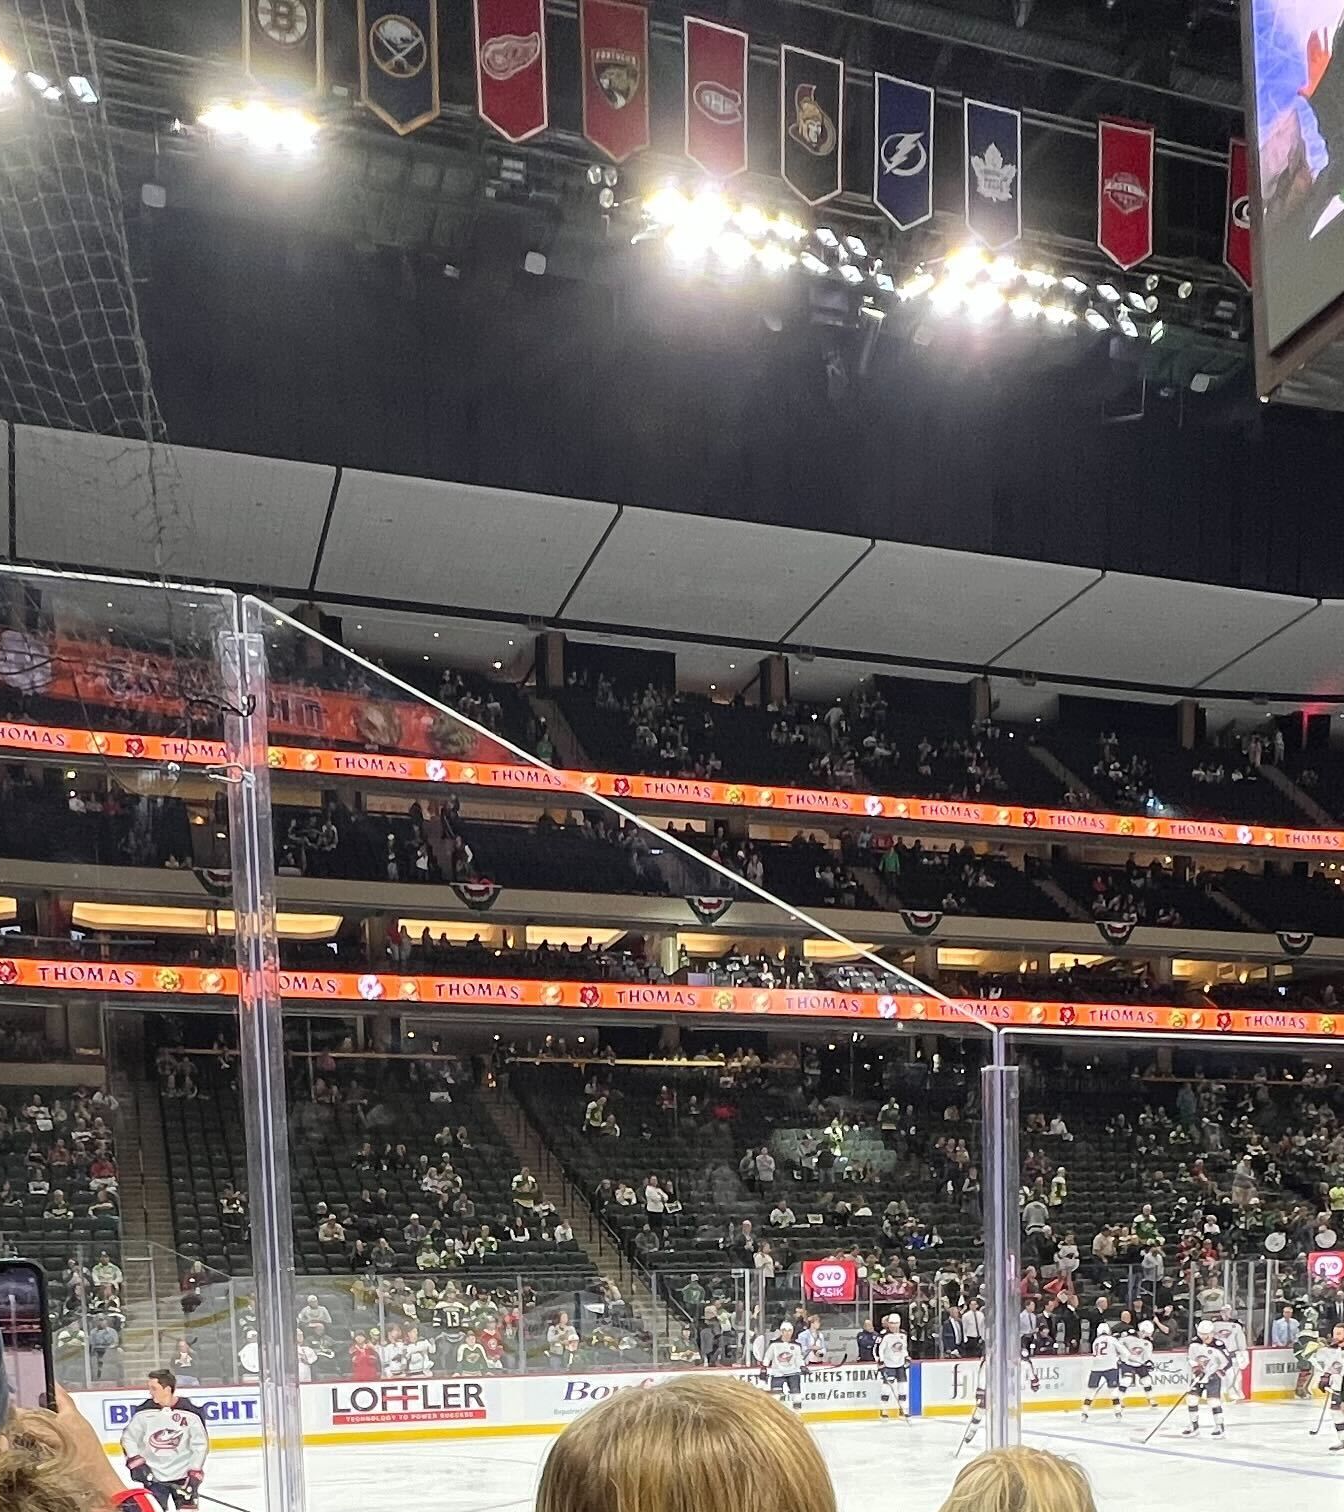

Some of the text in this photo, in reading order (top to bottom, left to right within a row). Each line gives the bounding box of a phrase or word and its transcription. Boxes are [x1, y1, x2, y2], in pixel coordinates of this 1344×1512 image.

[160, 742, 227, 760] THOMA
[333, 756, 408, 774] THOMAS
[490, 770, 561, 786] THOMAS
[643, 782, 712, 799] THOMAS
[785, 794, 850, 810] THOMAS
[920, 805, 981, 820] THOMAS
[1048, 814, 1105, 830] THOMAS
[1169, 823, 1224, 838] THOMAS
[1284, 834, 1340, 847] THOMAS
[38, 966, 136, 986] THOMAS
[435, 982, 521, 1002] THOMAS
[616, 989, 697, 1007] THOMAS
[785, 996, 860, 1013] THOMAS
[939, 1002, 1011, 1021] THOMAS
[1088, 1008, 1155, 1025] THOMAS
[1244, 1015, 1306, 1031] THOMAS
[817, 1271, 842, 1282] OVO
[846, 1370, 878, 1382] TODAY
[332, 1383, 486, 1413] LOFFLER
